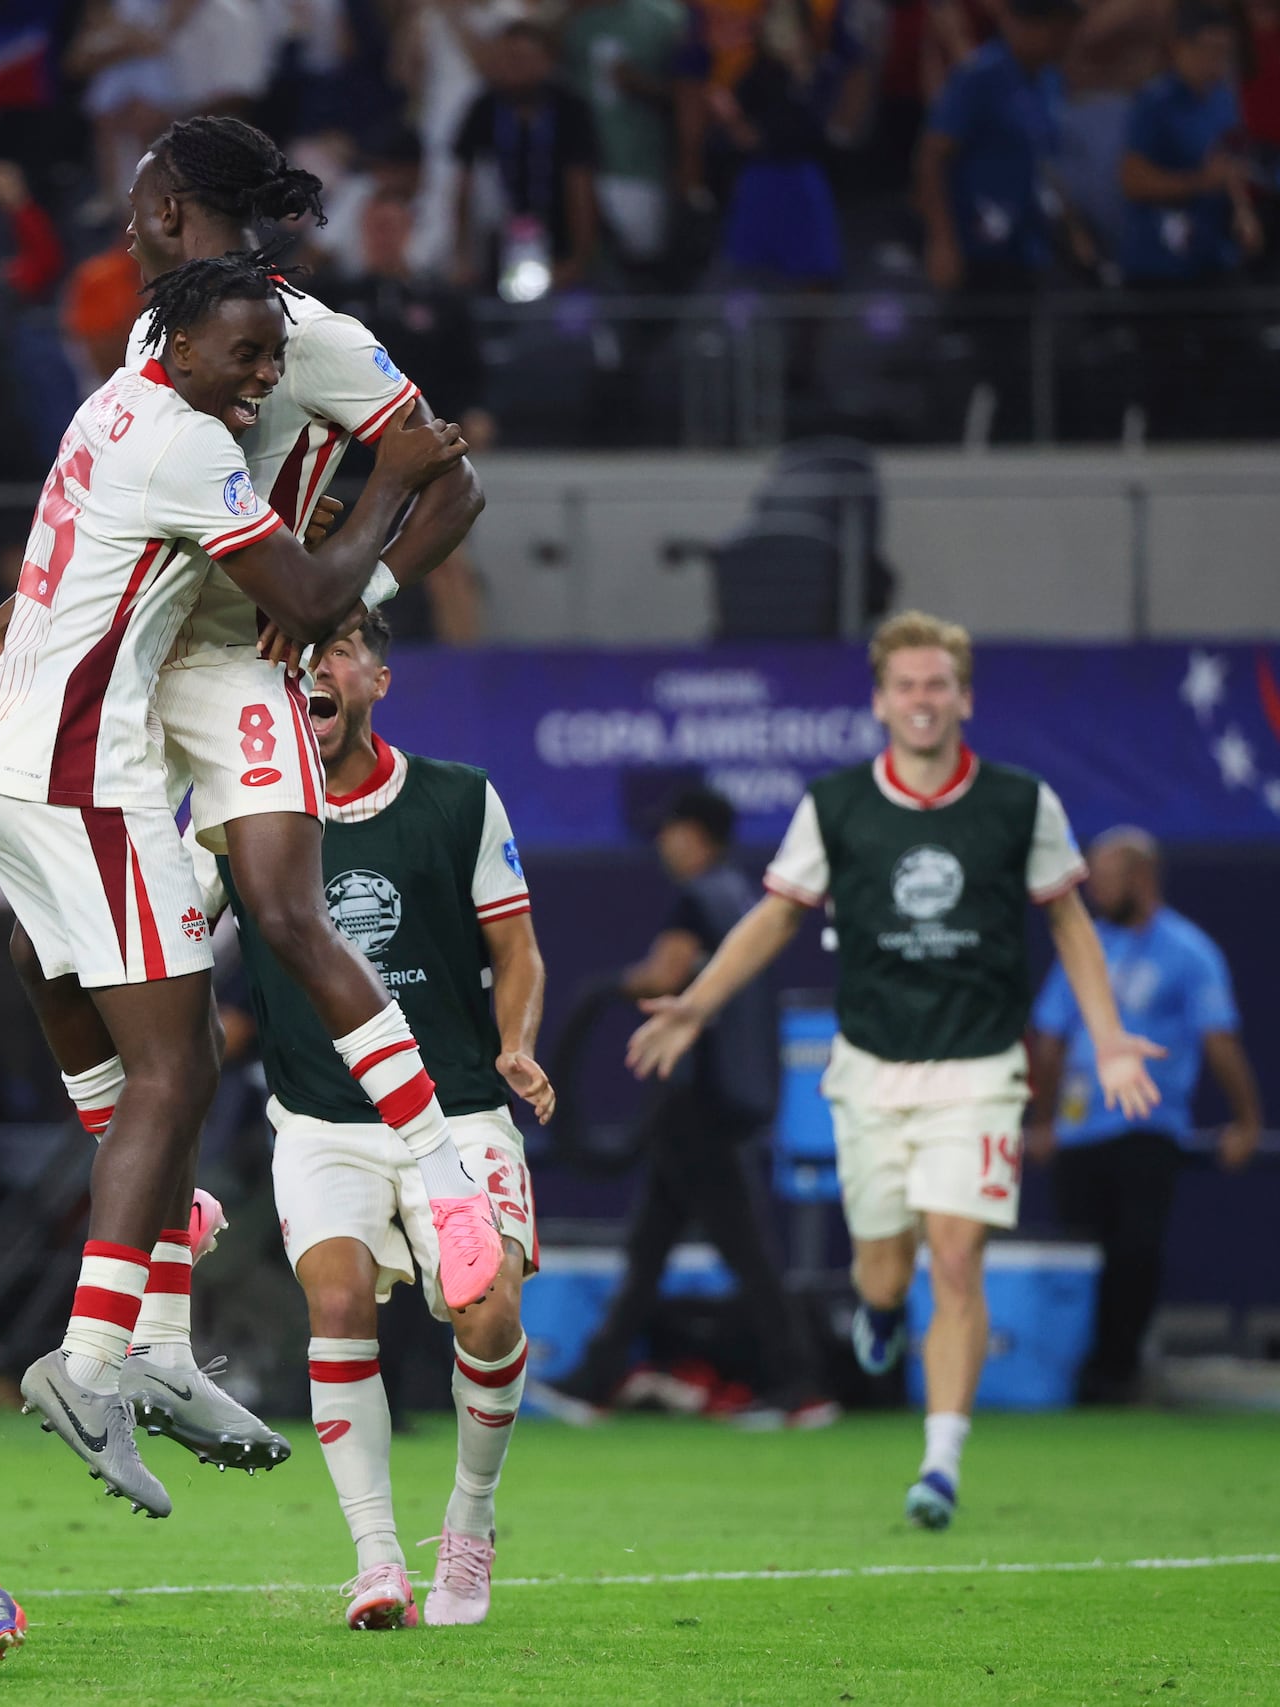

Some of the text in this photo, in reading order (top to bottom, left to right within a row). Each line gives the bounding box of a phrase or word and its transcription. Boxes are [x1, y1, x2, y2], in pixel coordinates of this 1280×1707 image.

[238, 703, 277, 764] 8
[536, 709, 668, 767] COPA
[181, 919, 206, 930] CANADA
[379, 967, 428, 986] ERICA
